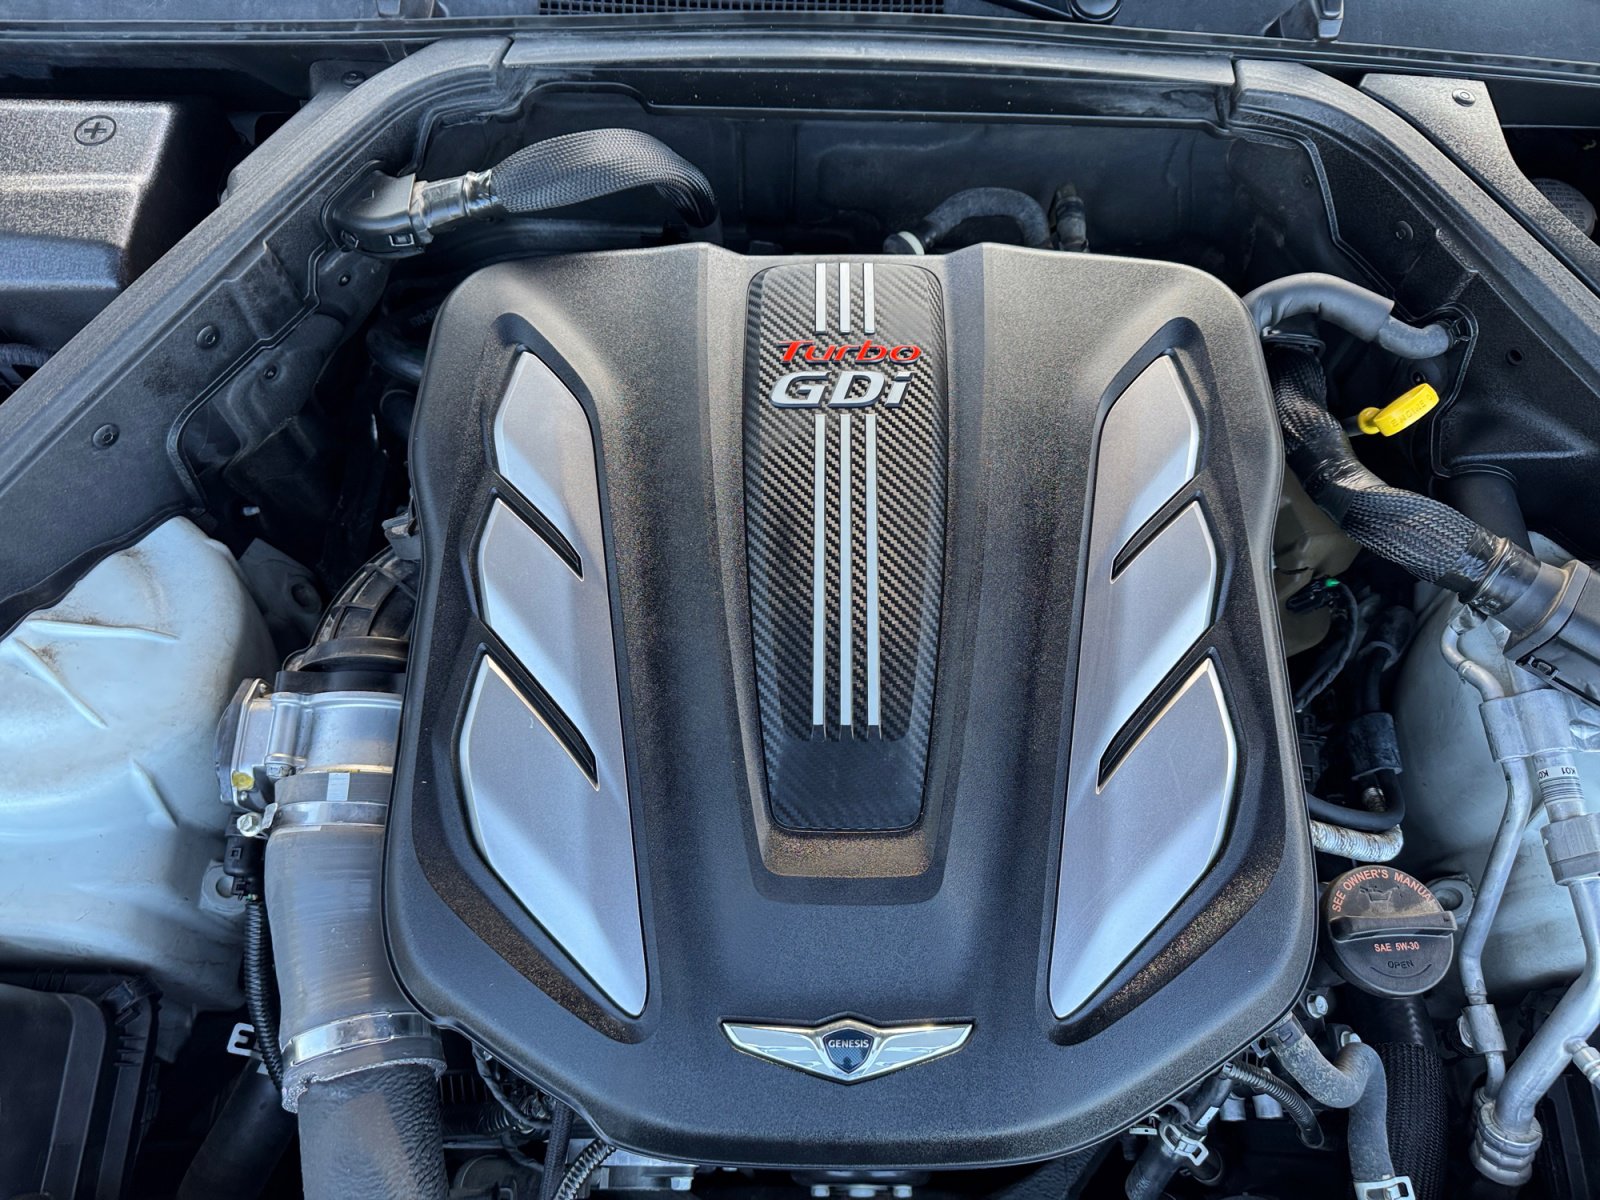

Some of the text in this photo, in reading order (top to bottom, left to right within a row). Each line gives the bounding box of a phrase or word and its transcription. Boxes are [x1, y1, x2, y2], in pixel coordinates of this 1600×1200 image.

[776, 339, 922, 364] Turbo
[770, 371, 914, 407] GDi
[1391, 399, 1426, 427] ENGINE
[1332, 890, 1346, 912] SEE
[1343, 869, 1389, 890] OWNER'S
[1374, 941, 1420, 952] SAE 5W-30
[1387, 960, 1415, 969] OPEN
[828, 1039, 869, 1048] GENESIS
